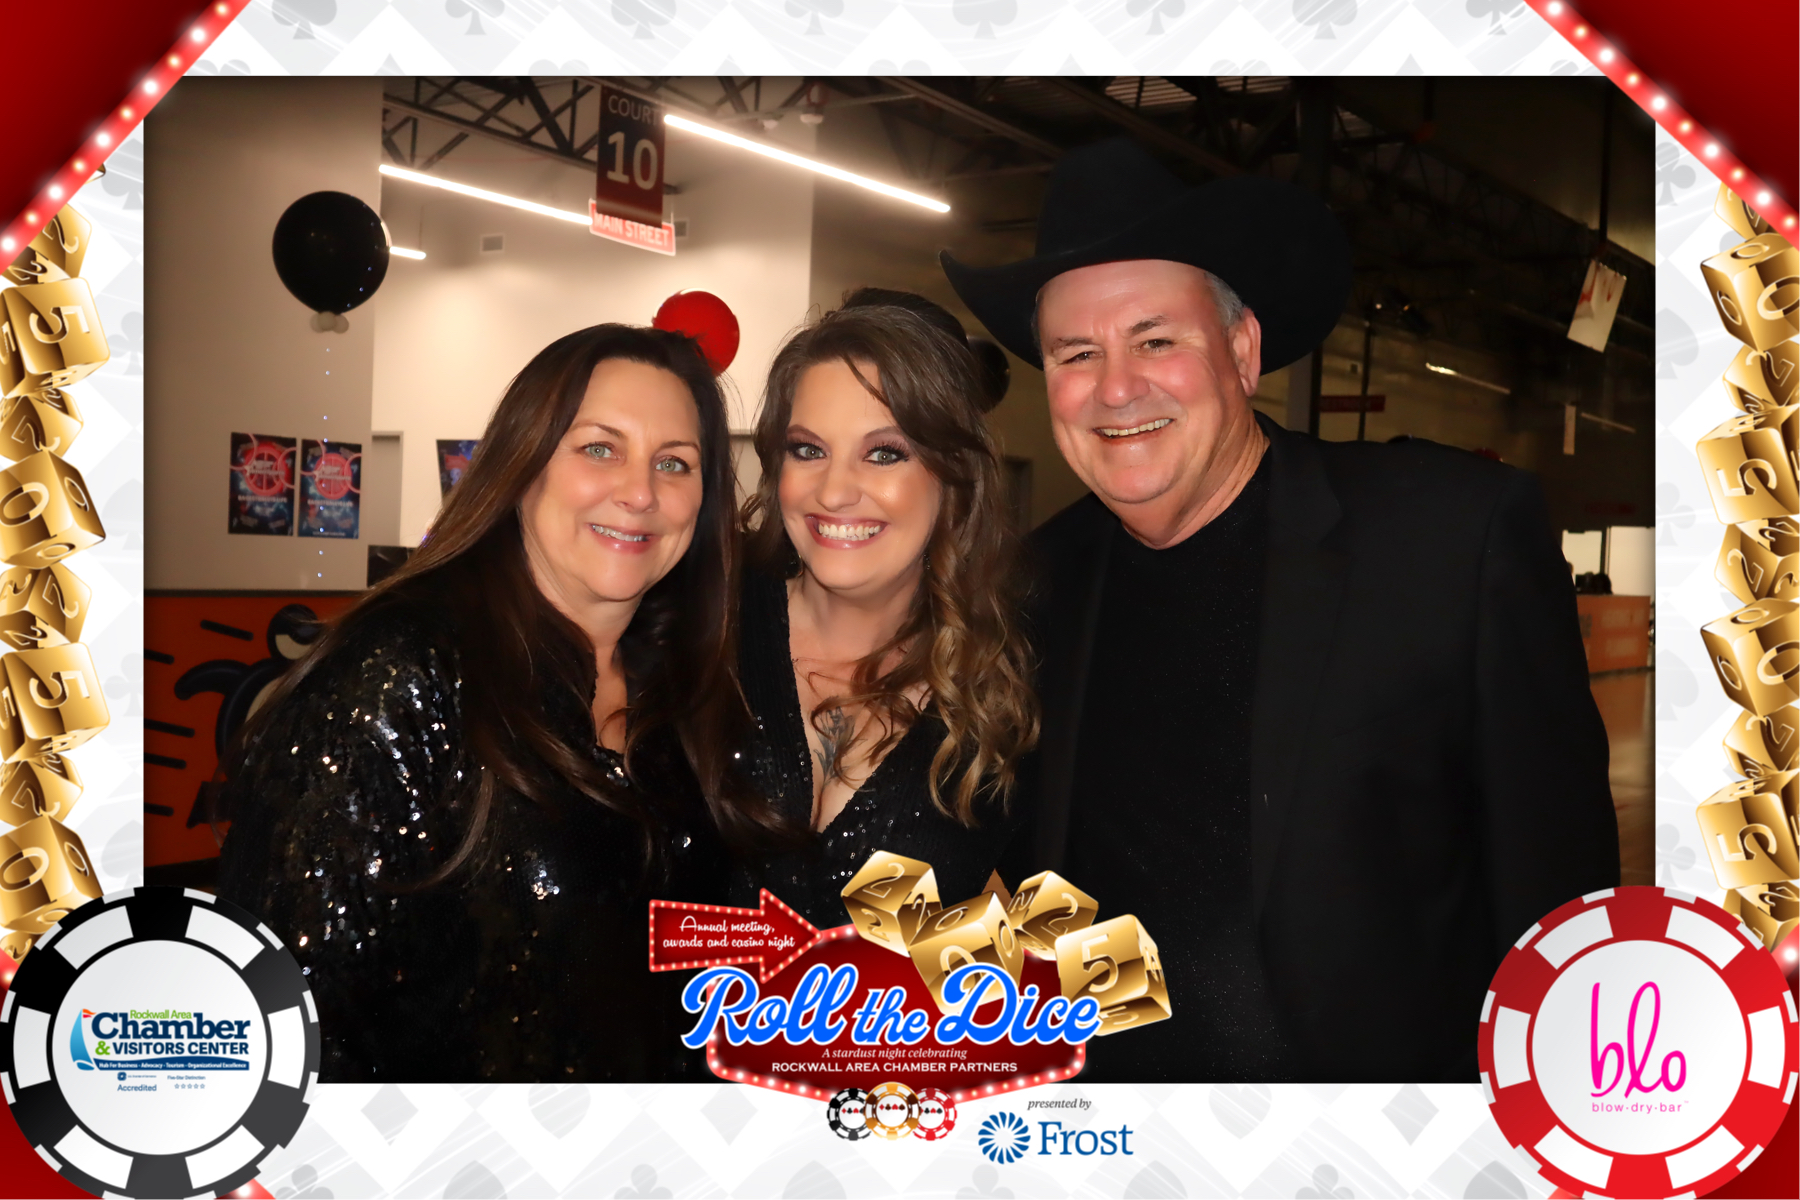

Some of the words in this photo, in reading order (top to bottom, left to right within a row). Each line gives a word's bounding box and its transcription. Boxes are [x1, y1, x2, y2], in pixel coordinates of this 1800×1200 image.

[608, 95, 660, 126] COURT
[607, 131, 658, 190] 10
[594, 210, 623, 235] MAIN
[625, 220, 670, 247] STREET
